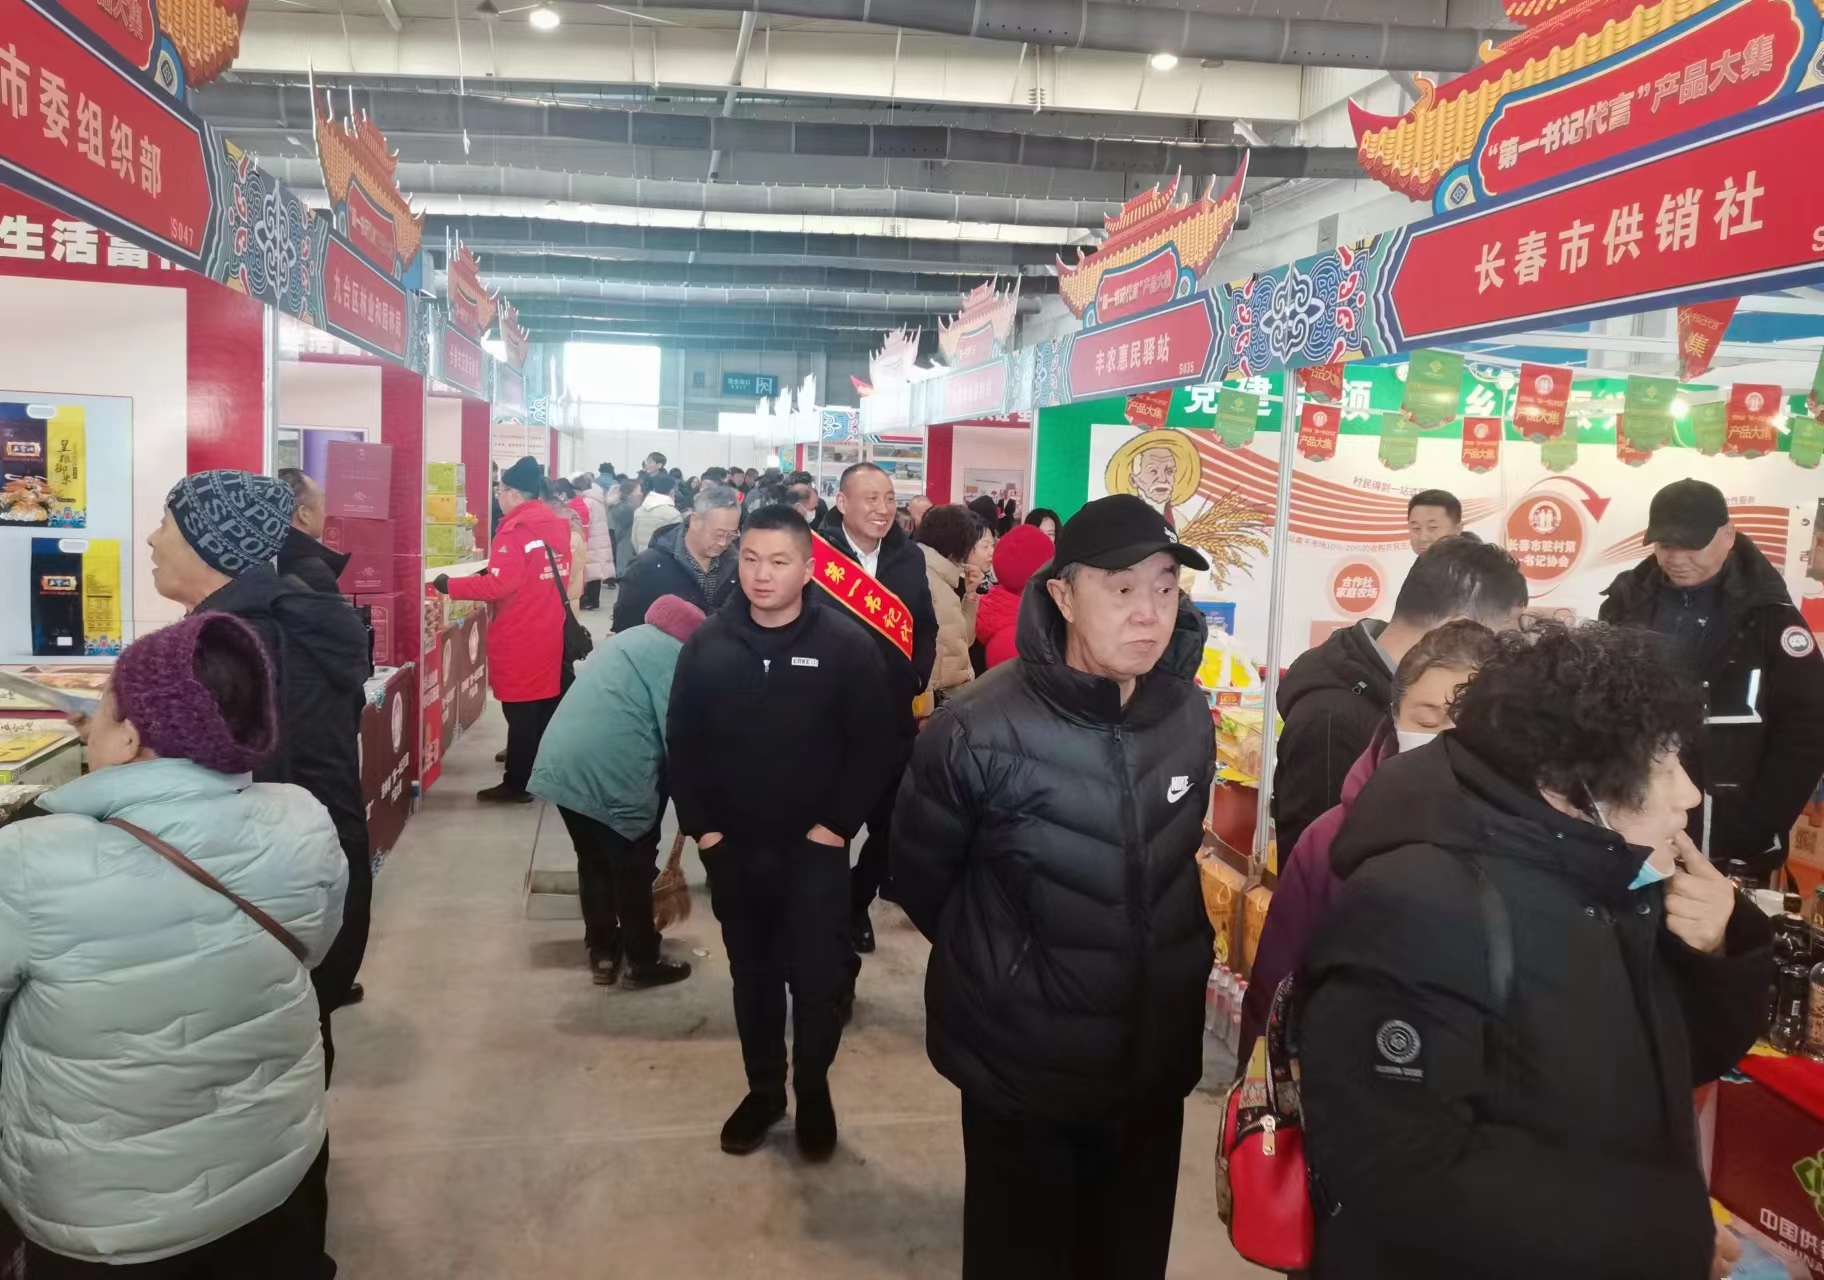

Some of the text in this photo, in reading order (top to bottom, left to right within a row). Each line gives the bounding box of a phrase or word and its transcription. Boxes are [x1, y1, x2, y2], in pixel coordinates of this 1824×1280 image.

[0, 43, 162, 199] 市委组织部
[1488, 34, 1774, 170] “第一书记代言”产品大集
[0, 214, 188, 270] 生活富
[1475, 170, 1765, 294] 长春市供销社
[1095, 333, 1170, 377] 丰农惠民驿站
[1341, 576, 1374, 588] 合作社
[1171, 775, 1189, 791] NIKE
[1760, 1207, 1824, 1260] 中国供
